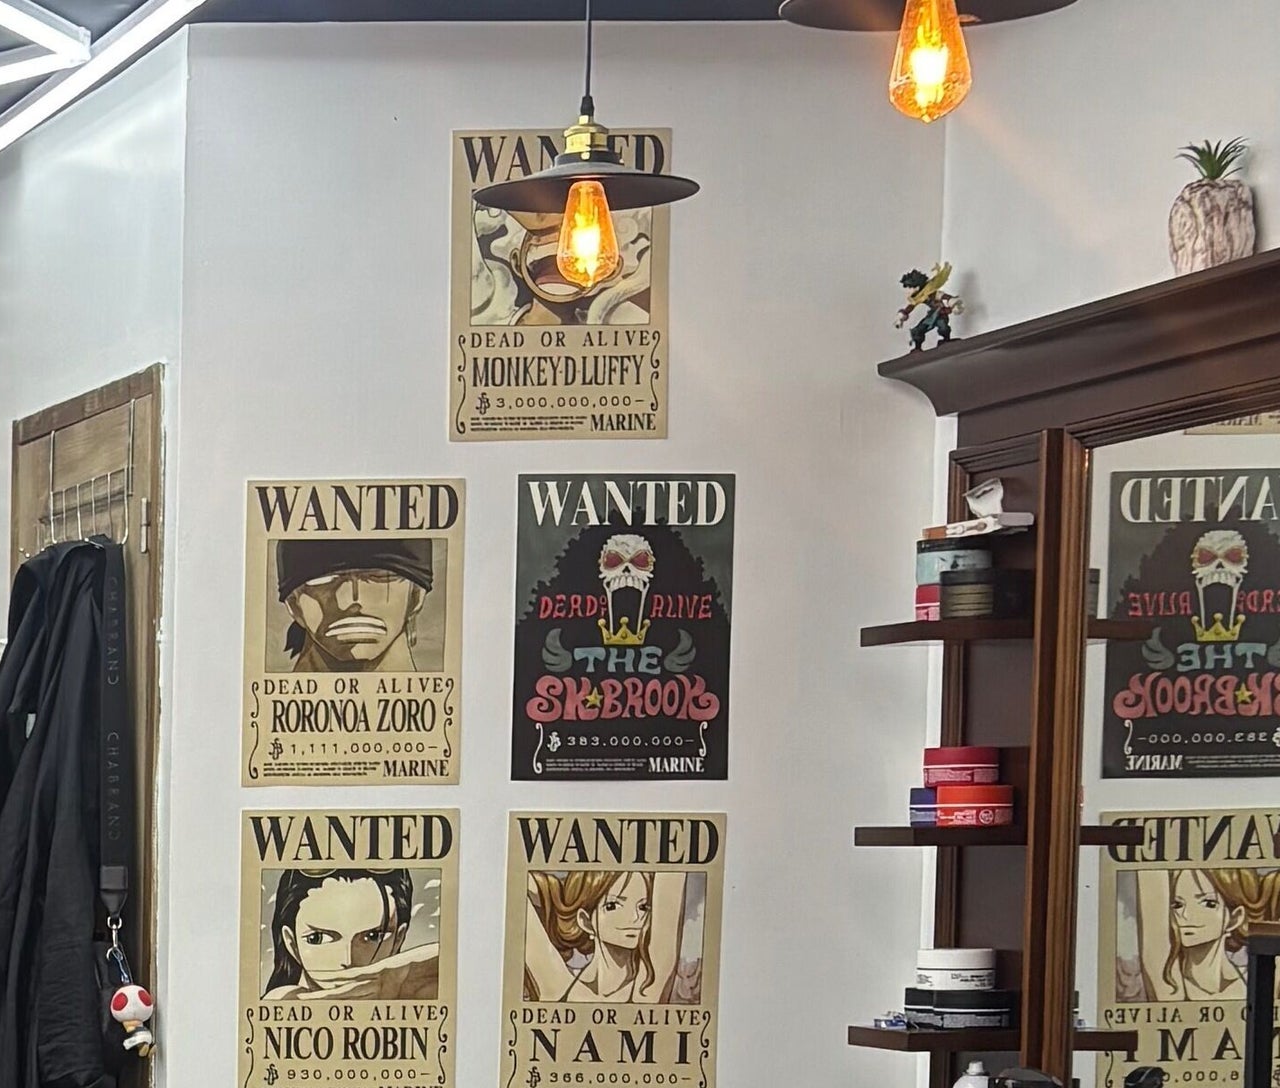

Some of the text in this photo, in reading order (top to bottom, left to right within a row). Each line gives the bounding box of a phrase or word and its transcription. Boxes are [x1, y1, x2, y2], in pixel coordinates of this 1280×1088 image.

[471, 331, 651, 348] DEAD OR ALIVE
[591, 414, 656, 431] MARINE
[255, 484, 459, 532] WANTED
[528, 480, 727, 526] WANTED
[540, 594, 598, 619] DEAD
[650, 594, 713, 619] ALIVE
[574, 646, 663, 674] THE
[264, 678, 443, 695] DEAD OR ALIVE
[271, 699, 436, 733] RORONOA ZORO
[383, 760, 449, 777] MARINE
[648, 757, 705, 773] MARINE
[250, 815, 453, 862] WANTED
[517, 817, 719, 865] WANTED
[259, 1005, 438, 1021] DEAD OR ALIVE
[522, 1009, 702, 1026] DEAD OR ALIVE
[263, 1026, 429, 1061] NICO ROBIN
[529, 1028, 693, 1065] NAMI
